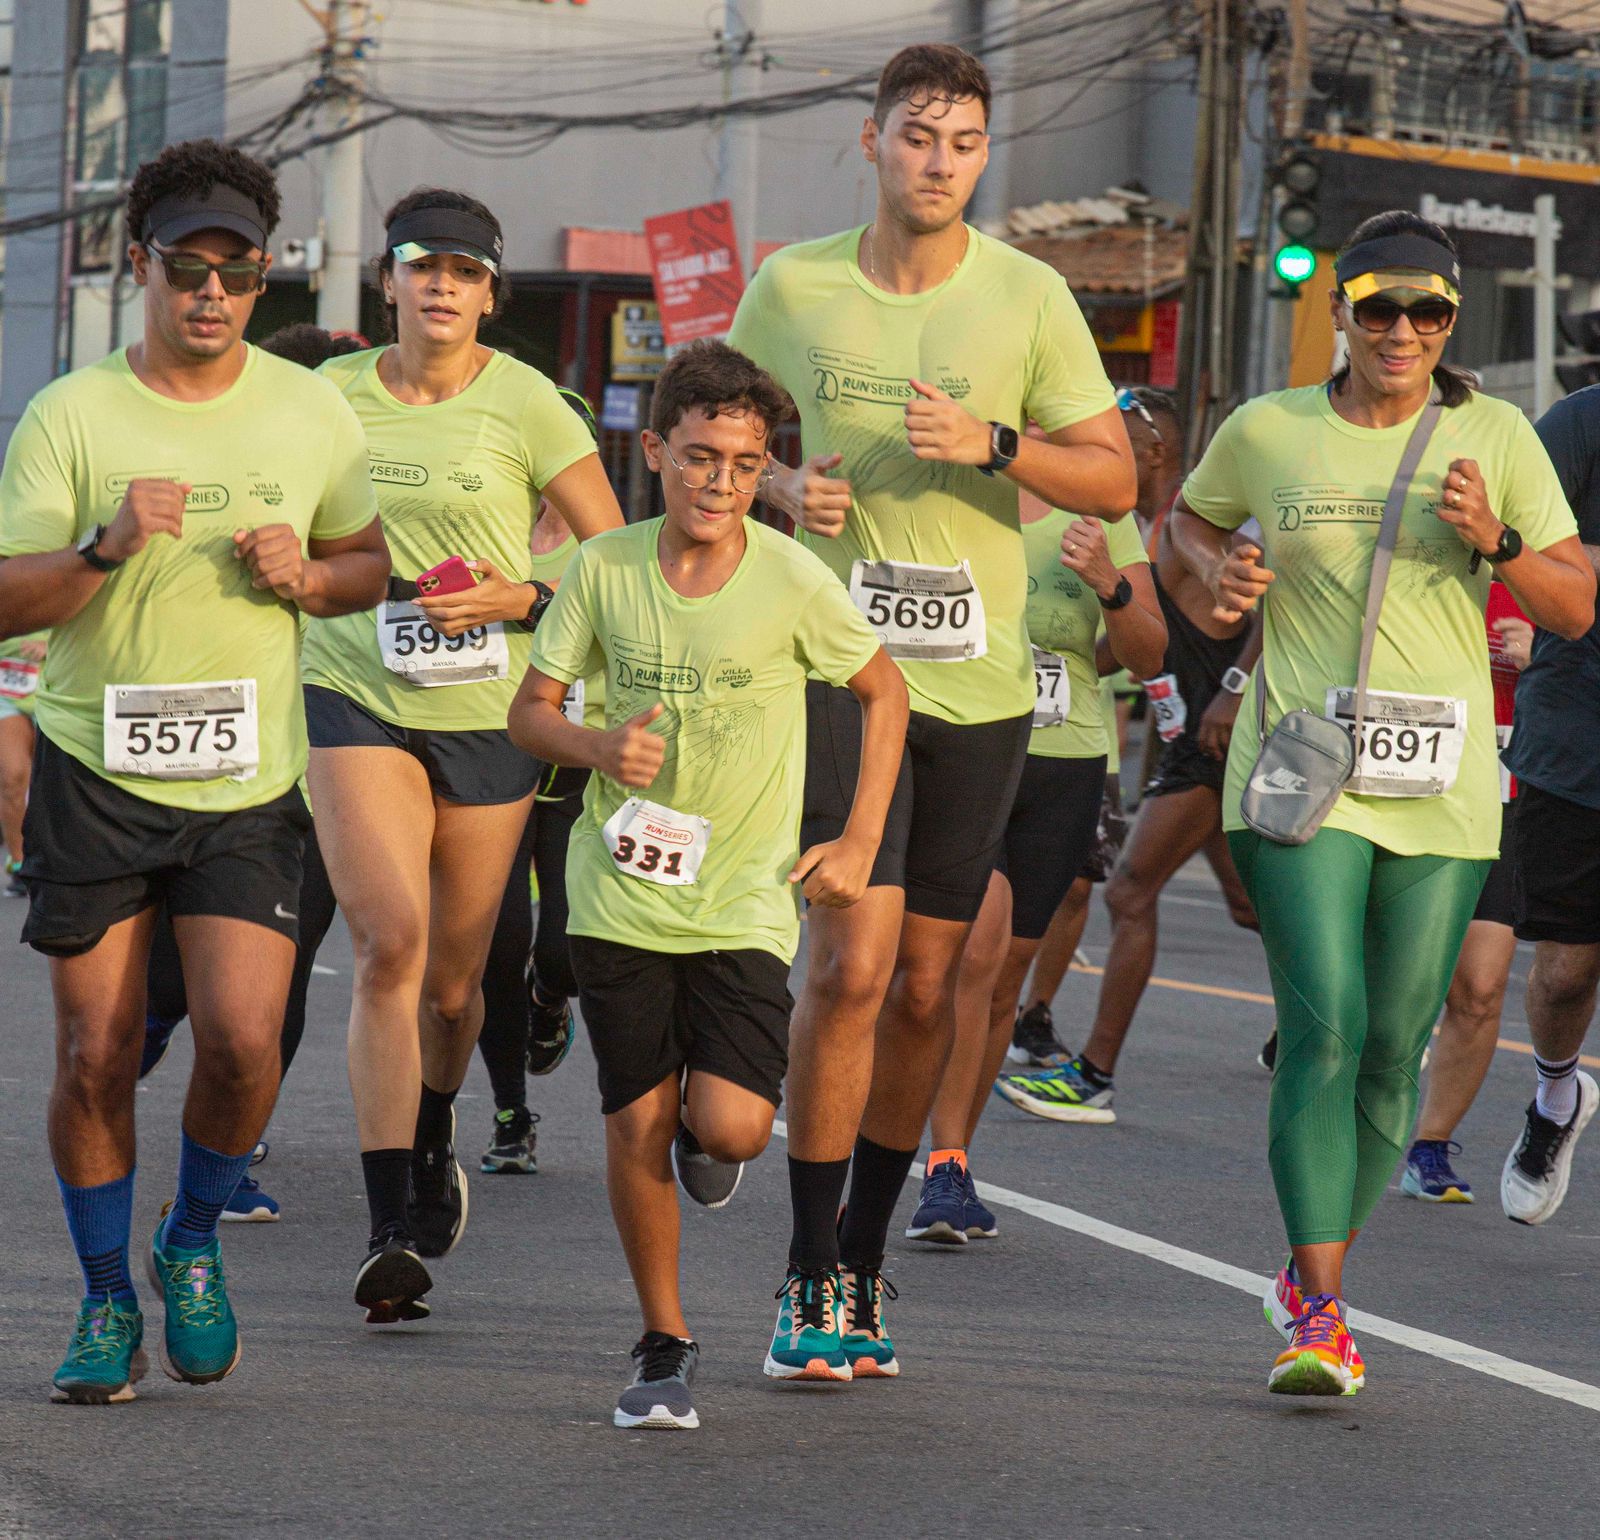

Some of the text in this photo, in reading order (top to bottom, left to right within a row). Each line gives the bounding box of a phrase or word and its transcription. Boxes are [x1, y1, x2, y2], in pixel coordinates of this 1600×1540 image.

[447, 476, 484, 486] FORMA
[453, 470, 481, 479] VILLA
[867, 592, 970, 630] 5690
[394, 623, 488, 657] 5999
[715, 675, 753, 684] FORMA
[722, 668, 751, 676] VILLA
[127, 718, 237, 755] 5575
[612, 834, 683, 877] 331
